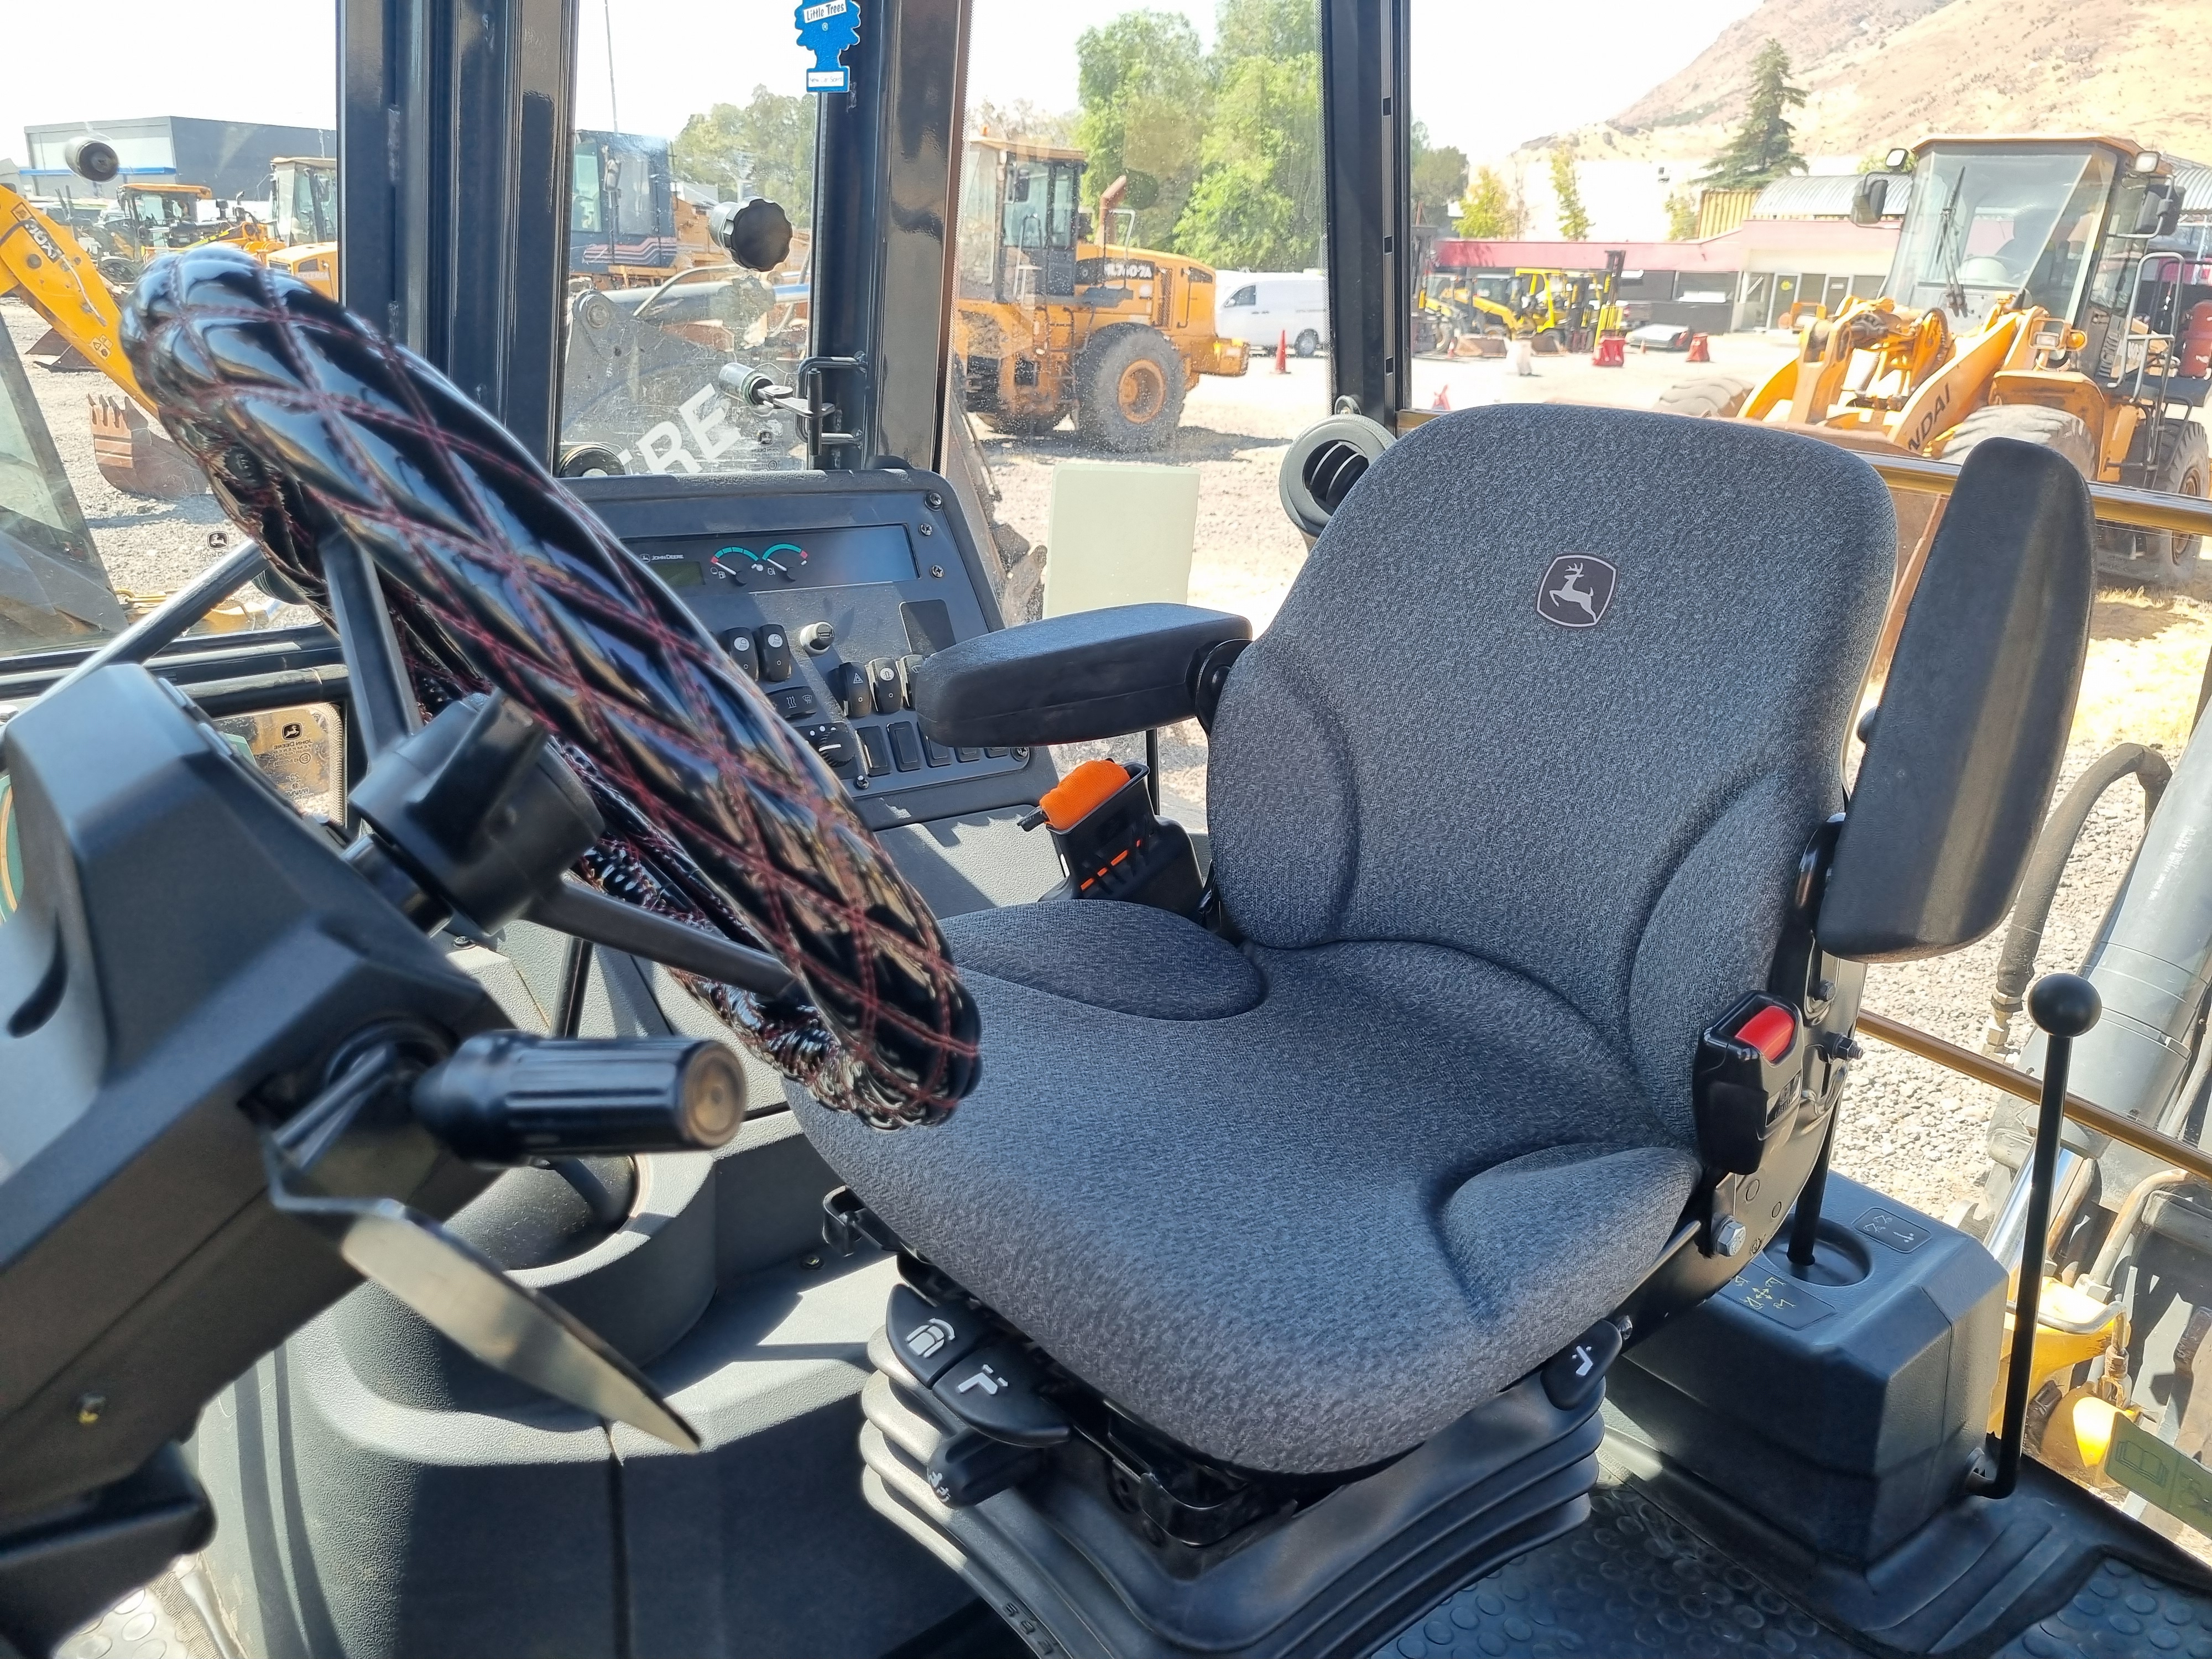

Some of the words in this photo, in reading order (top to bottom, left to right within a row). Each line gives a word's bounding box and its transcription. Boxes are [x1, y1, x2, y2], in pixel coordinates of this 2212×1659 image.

[807, 7, 824, 21] Little
[826, 3, 844, 15] Trees
[617, 383, 741, 474] RE
[1908, 382, 1950, 451] NDAI
